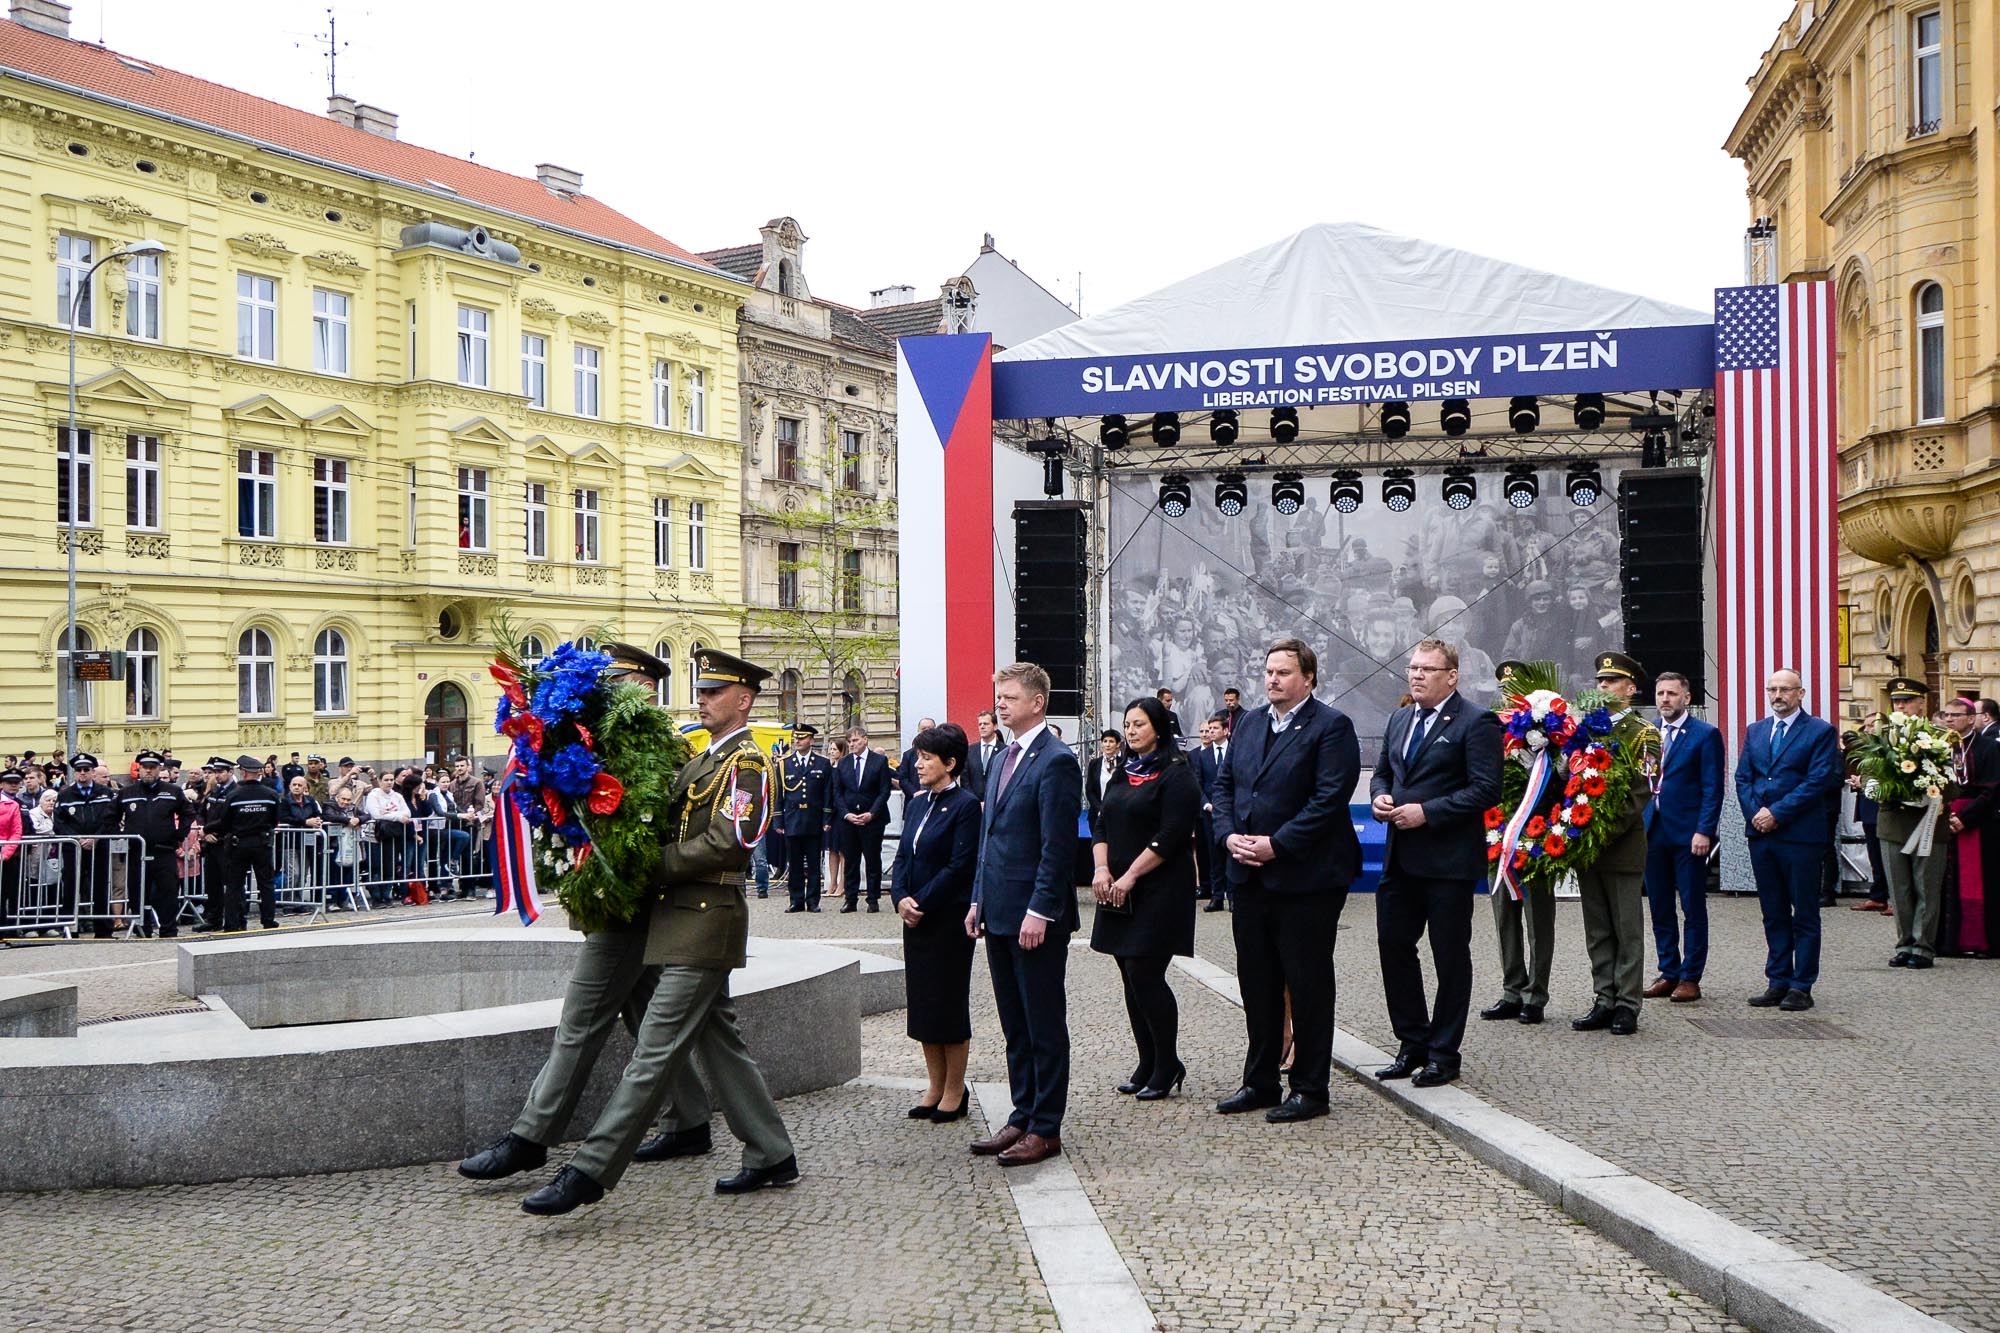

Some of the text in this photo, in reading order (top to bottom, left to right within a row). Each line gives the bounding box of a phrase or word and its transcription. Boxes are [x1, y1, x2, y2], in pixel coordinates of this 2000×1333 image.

[1081, 331, 1618, 393] SLAVNOSTI SVOBODY PLZEŇ
[1203, 380, 1481, 407] LIBERATION FESTIVAL PILSEN
